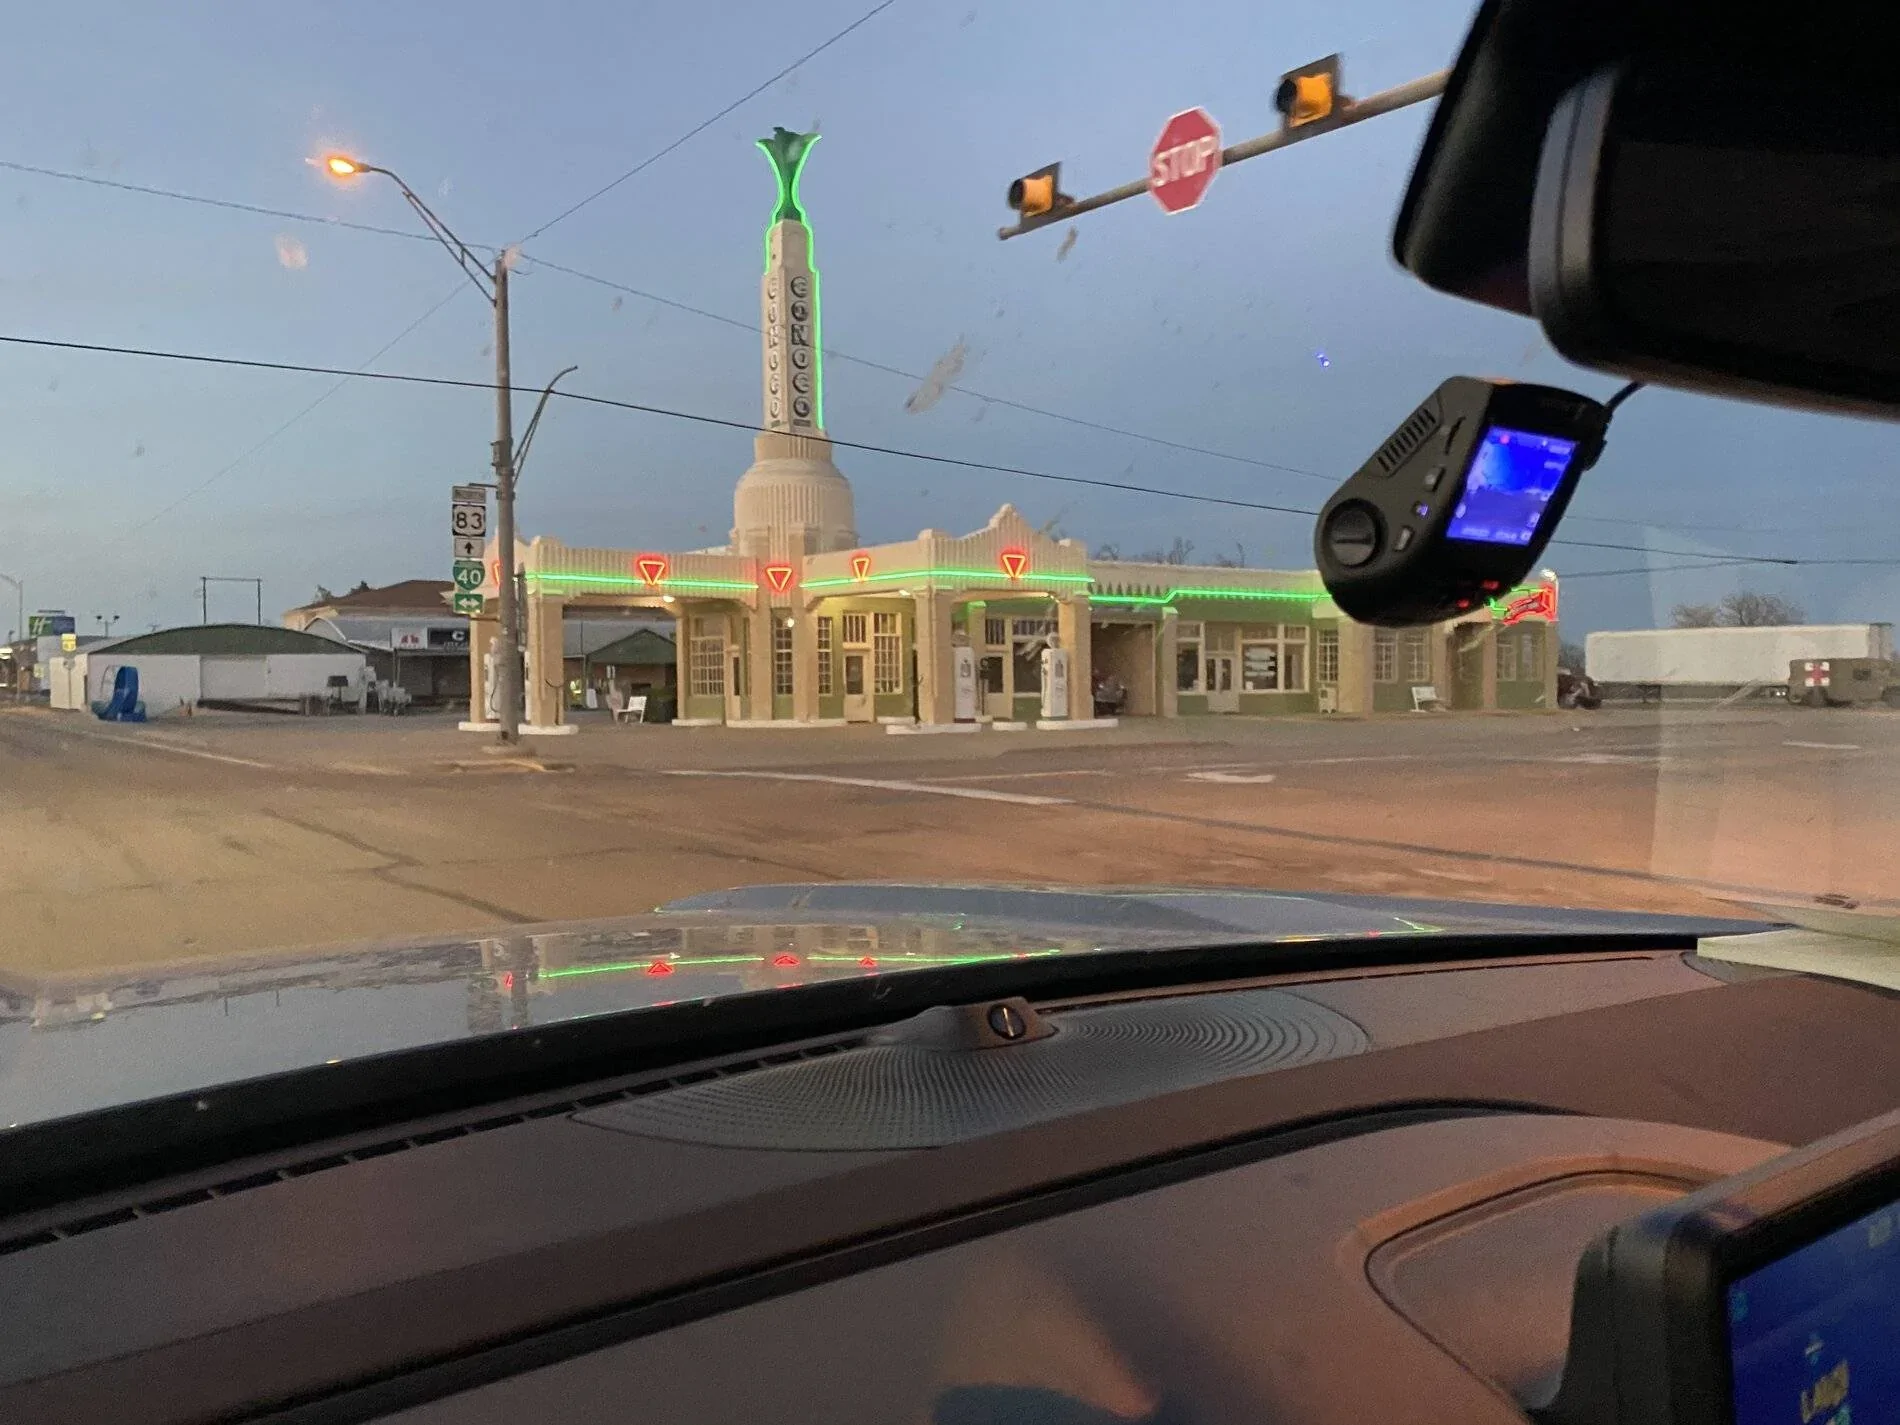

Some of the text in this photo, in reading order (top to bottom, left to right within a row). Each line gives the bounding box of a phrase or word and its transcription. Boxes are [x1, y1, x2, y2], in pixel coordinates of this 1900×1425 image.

[1151, 134, 1219, 187] STOP
[790, 276, 811, 418] CONOCO
[456, 512, 482, 529] 83
[458, 569, 481, 584] 40
